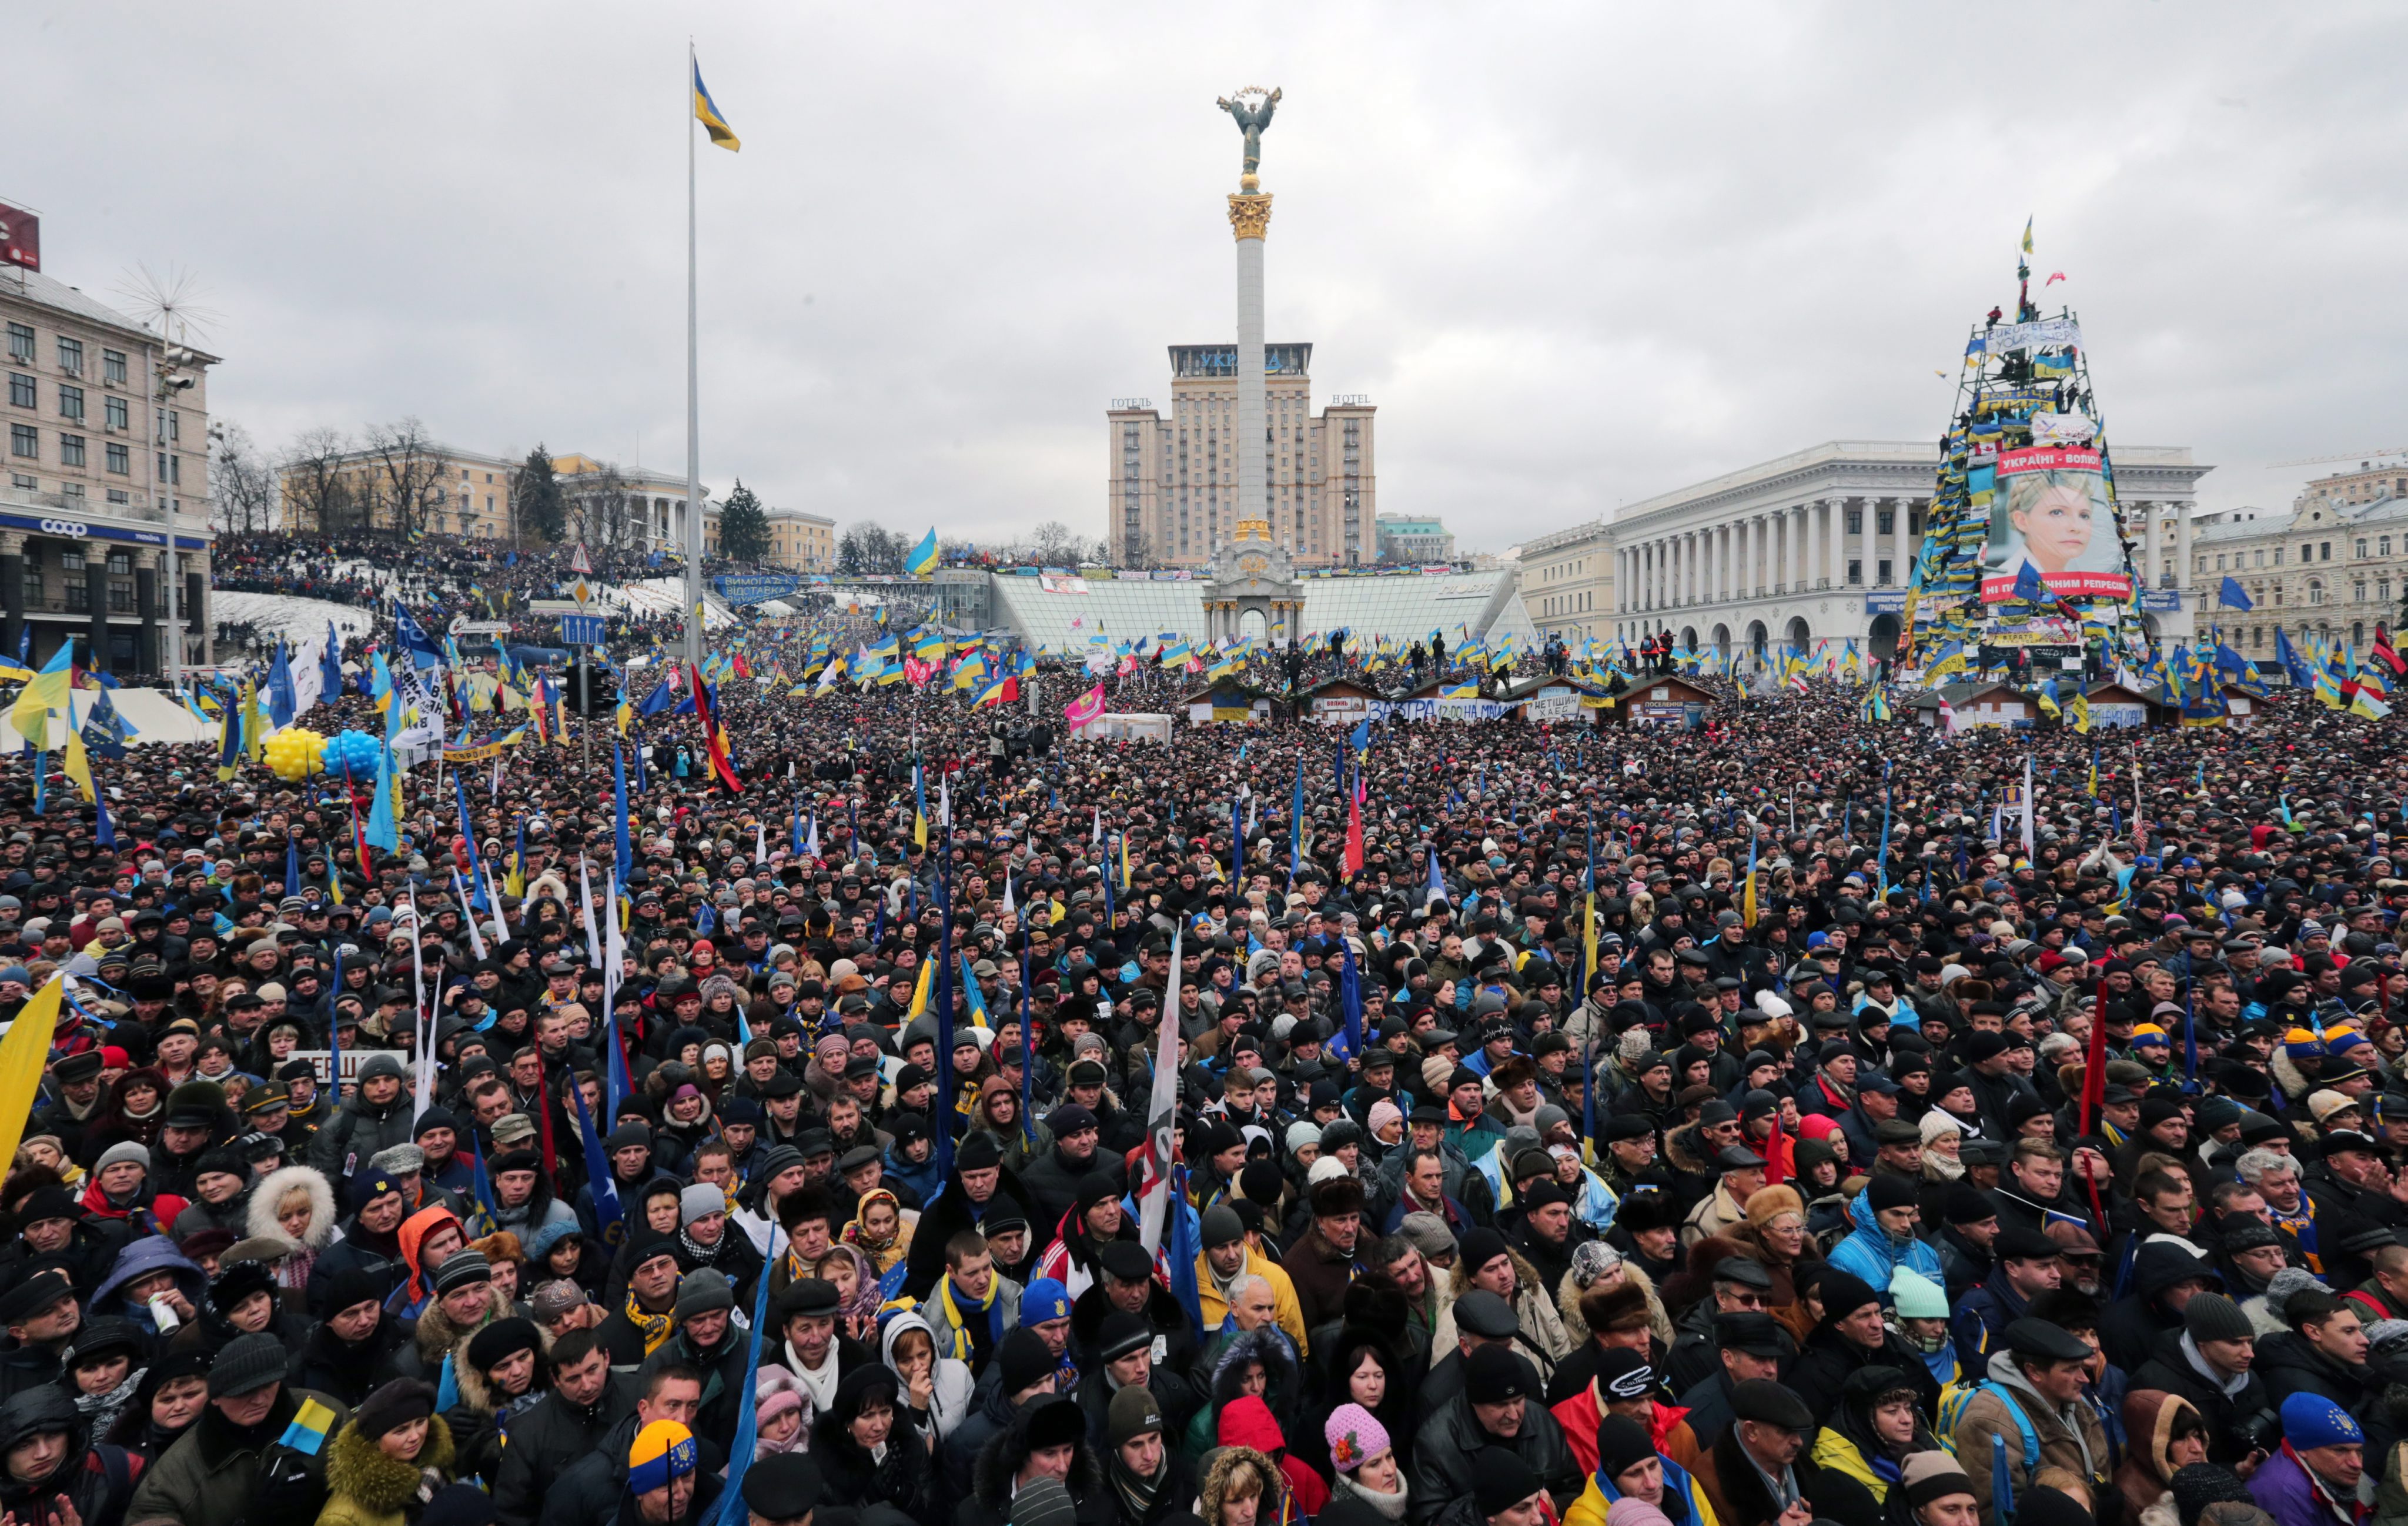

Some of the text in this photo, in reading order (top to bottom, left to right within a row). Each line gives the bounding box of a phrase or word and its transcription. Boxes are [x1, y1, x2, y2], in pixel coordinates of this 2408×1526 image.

[1112, 398, 1152, 408] ГОТЕЛЬ
[1333, 395, 1371, 403] HOTEL
[2004, 455, 2054, 469] УКРАЇНІ
[2066, 454, 2099, 465] ВОЛЮ!
[41, 519, 88, 539] coop
[727, 586, 786, 596] ВІДСТАВКА
[1986, 586, 1998, 595] НІ
[449, 615, 512, 635] Champions
[1535, 696, 1577, 710] НЕТІШИН
[1438, 705, 1461, 719] 12:00
[1464, 705, 1476, 719] НА
[453, 747, 490, 759] ЄВРОПУ
[1627, 1375, 1654, 1385] SUBARU
